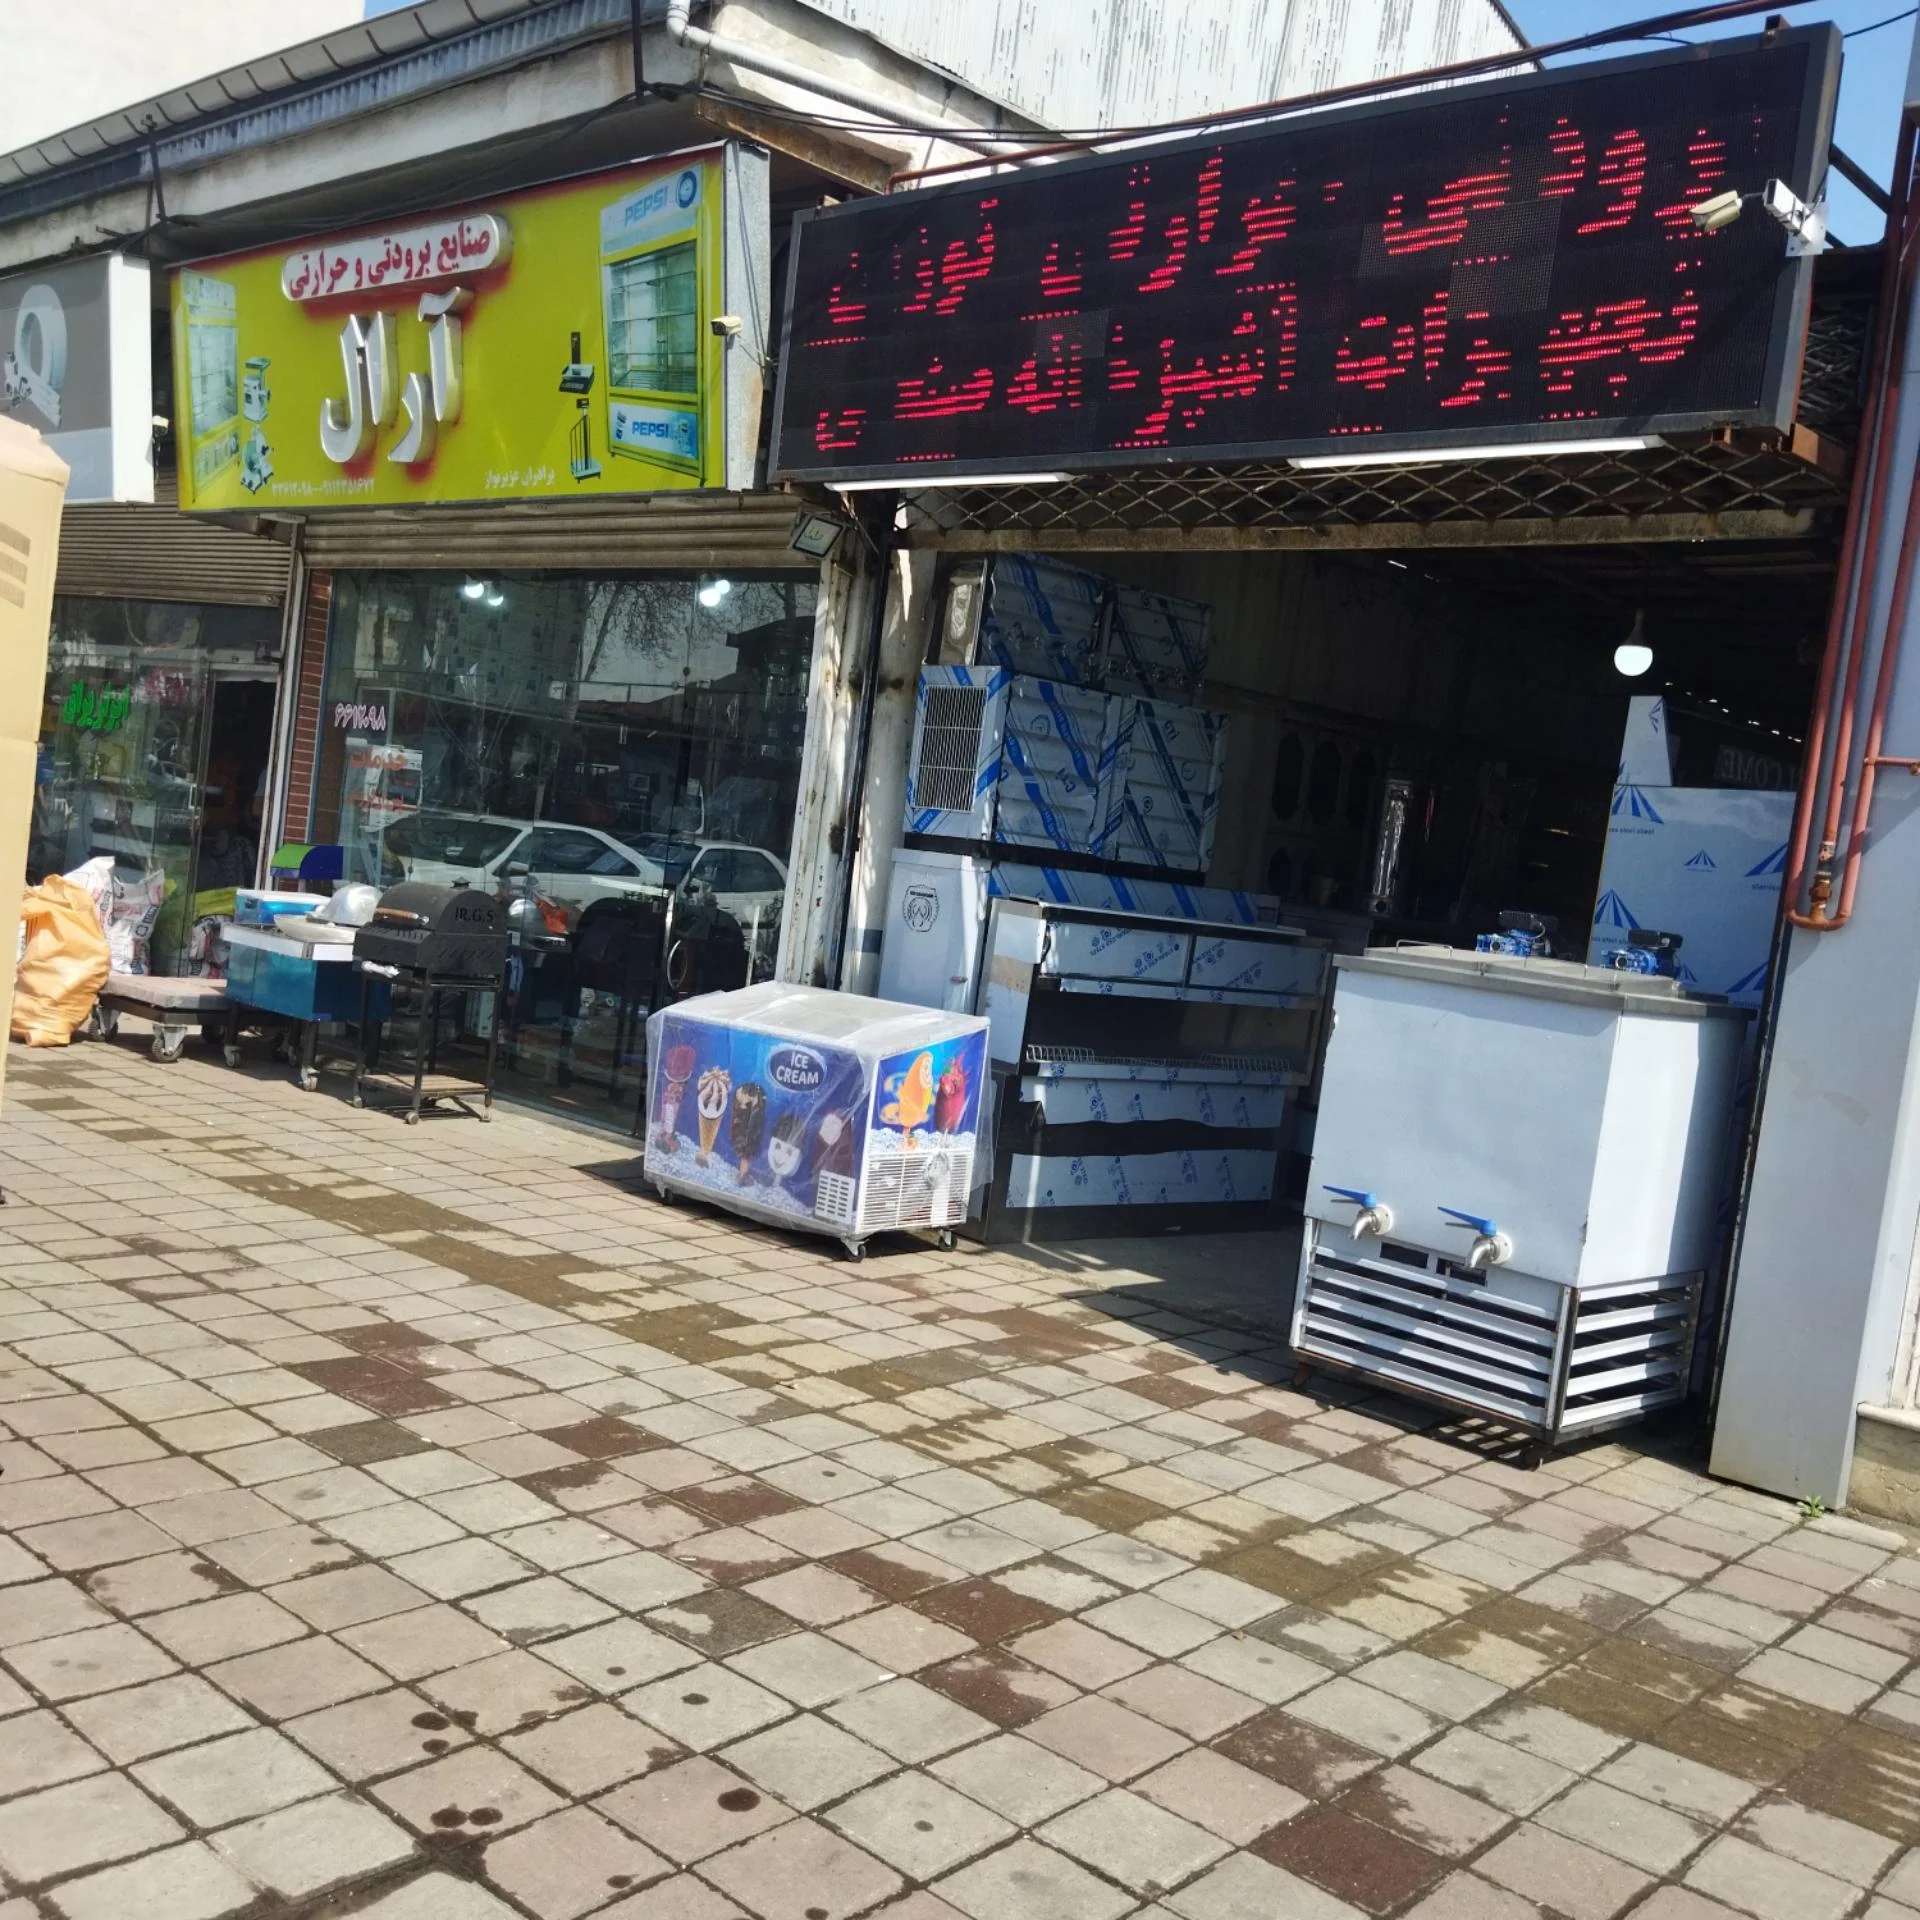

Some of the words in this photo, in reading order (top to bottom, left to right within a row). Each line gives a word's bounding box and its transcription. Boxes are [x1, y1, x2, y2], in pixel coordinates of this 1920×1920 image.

[624, 185, 668, 227] PEPSI
[368, 237, 431, 285] برودتی
[437, 221, 491, 274] صنایع
[290, 250, 349, 299] حرارتی
[354, 257, 363, 289] و
[319, 286, 474, 463] آرال
[631, 420, 669, 438] PEPSI
[776, 1064, 820, 1086] CREAM
[790, 1051, 809, 1069] ICE
